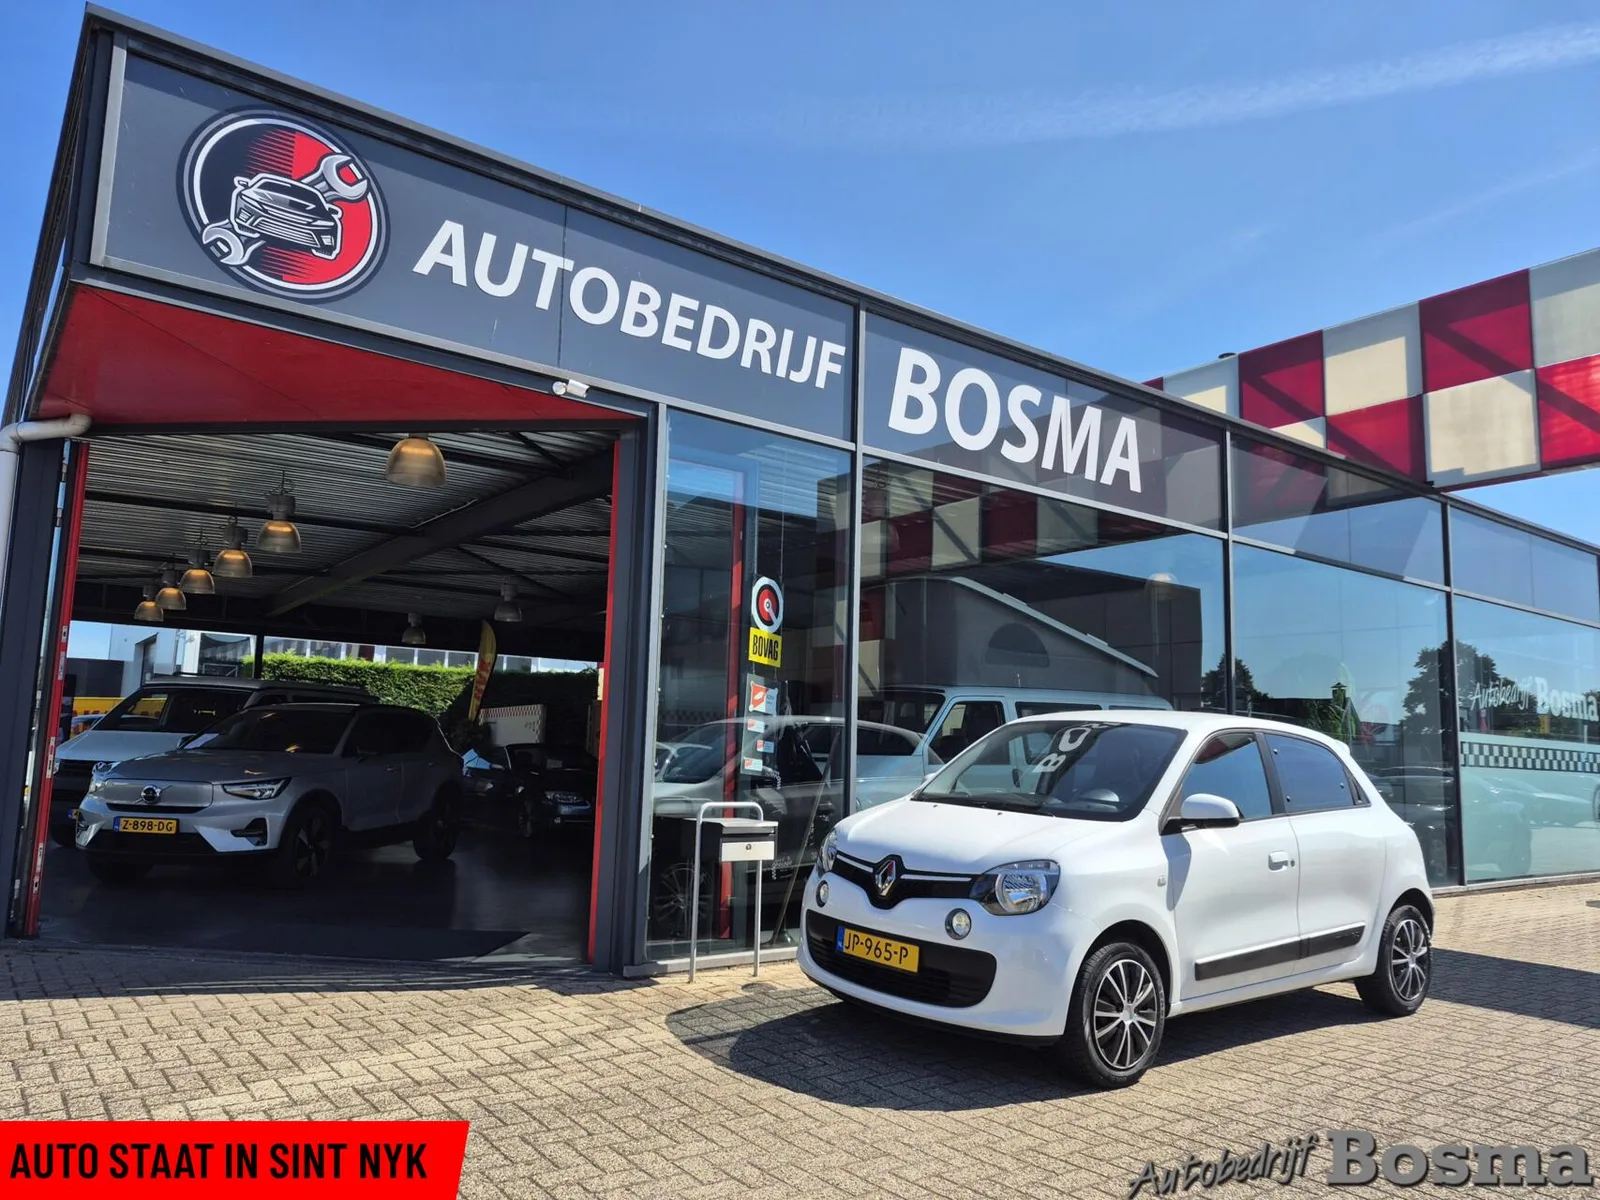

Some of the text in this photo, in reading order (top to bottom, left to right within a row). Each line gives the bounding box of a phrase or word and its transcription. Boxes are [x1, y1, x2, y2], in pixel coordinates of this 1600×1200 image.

[413, 220, 1143, 494] AUTOBEDRIJF BOSMA
[752, 633, 779, 661] BOVAG
[1535, 676, 1599, 722] Bosma
[122, 819, 173, 832] Z-898-DG
[844, 932, 908, 965] JP-965-P
